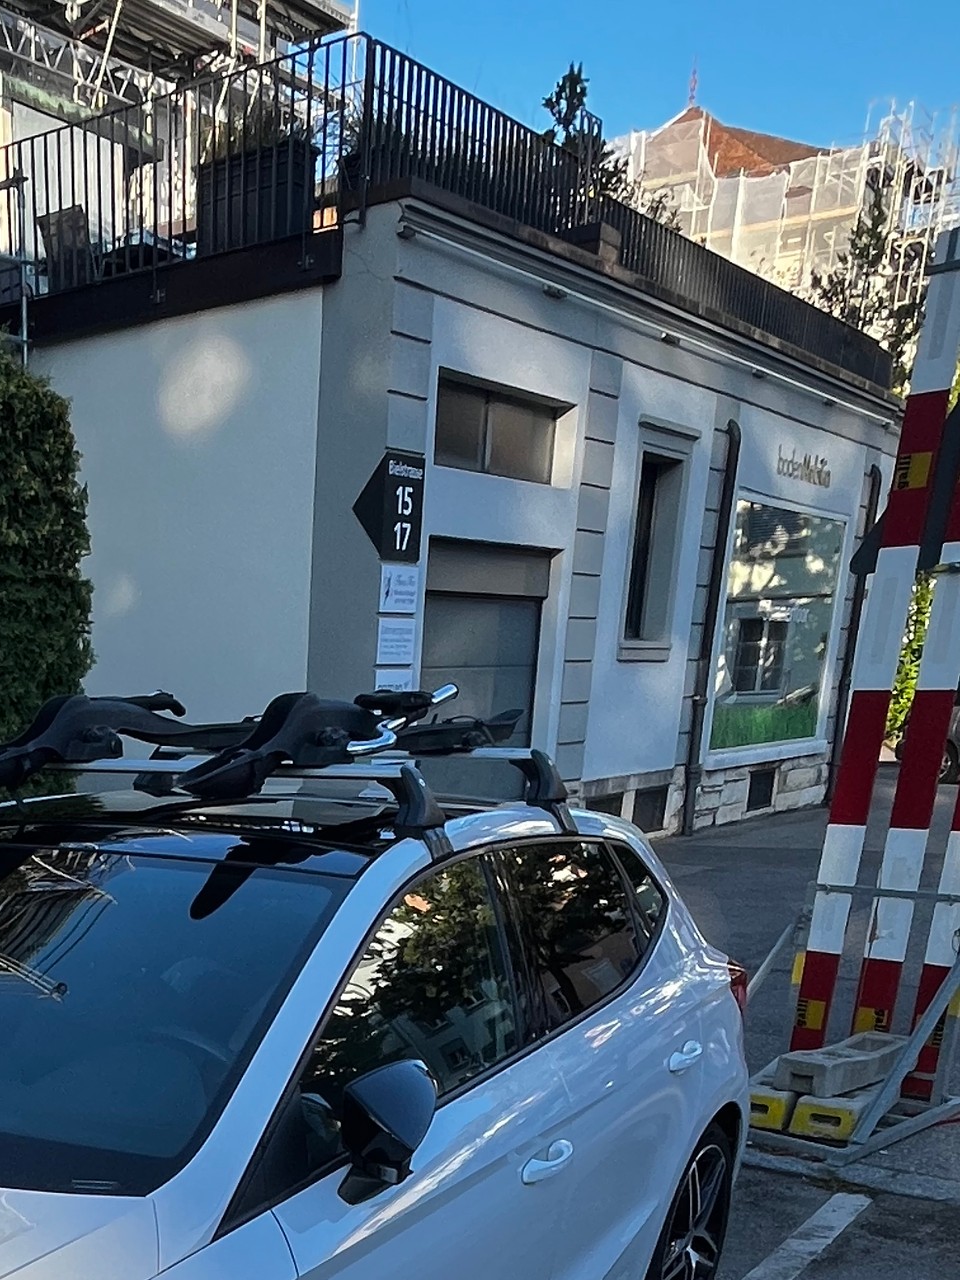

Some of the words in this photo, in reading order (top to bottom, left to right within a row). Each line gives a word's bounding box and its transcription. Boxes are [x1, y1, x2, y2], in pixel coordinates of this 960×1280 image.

[396, 486, 413, 515] 15
[394, 522, 411, 550] 17
[874, 1009, 889, 1033] gall
